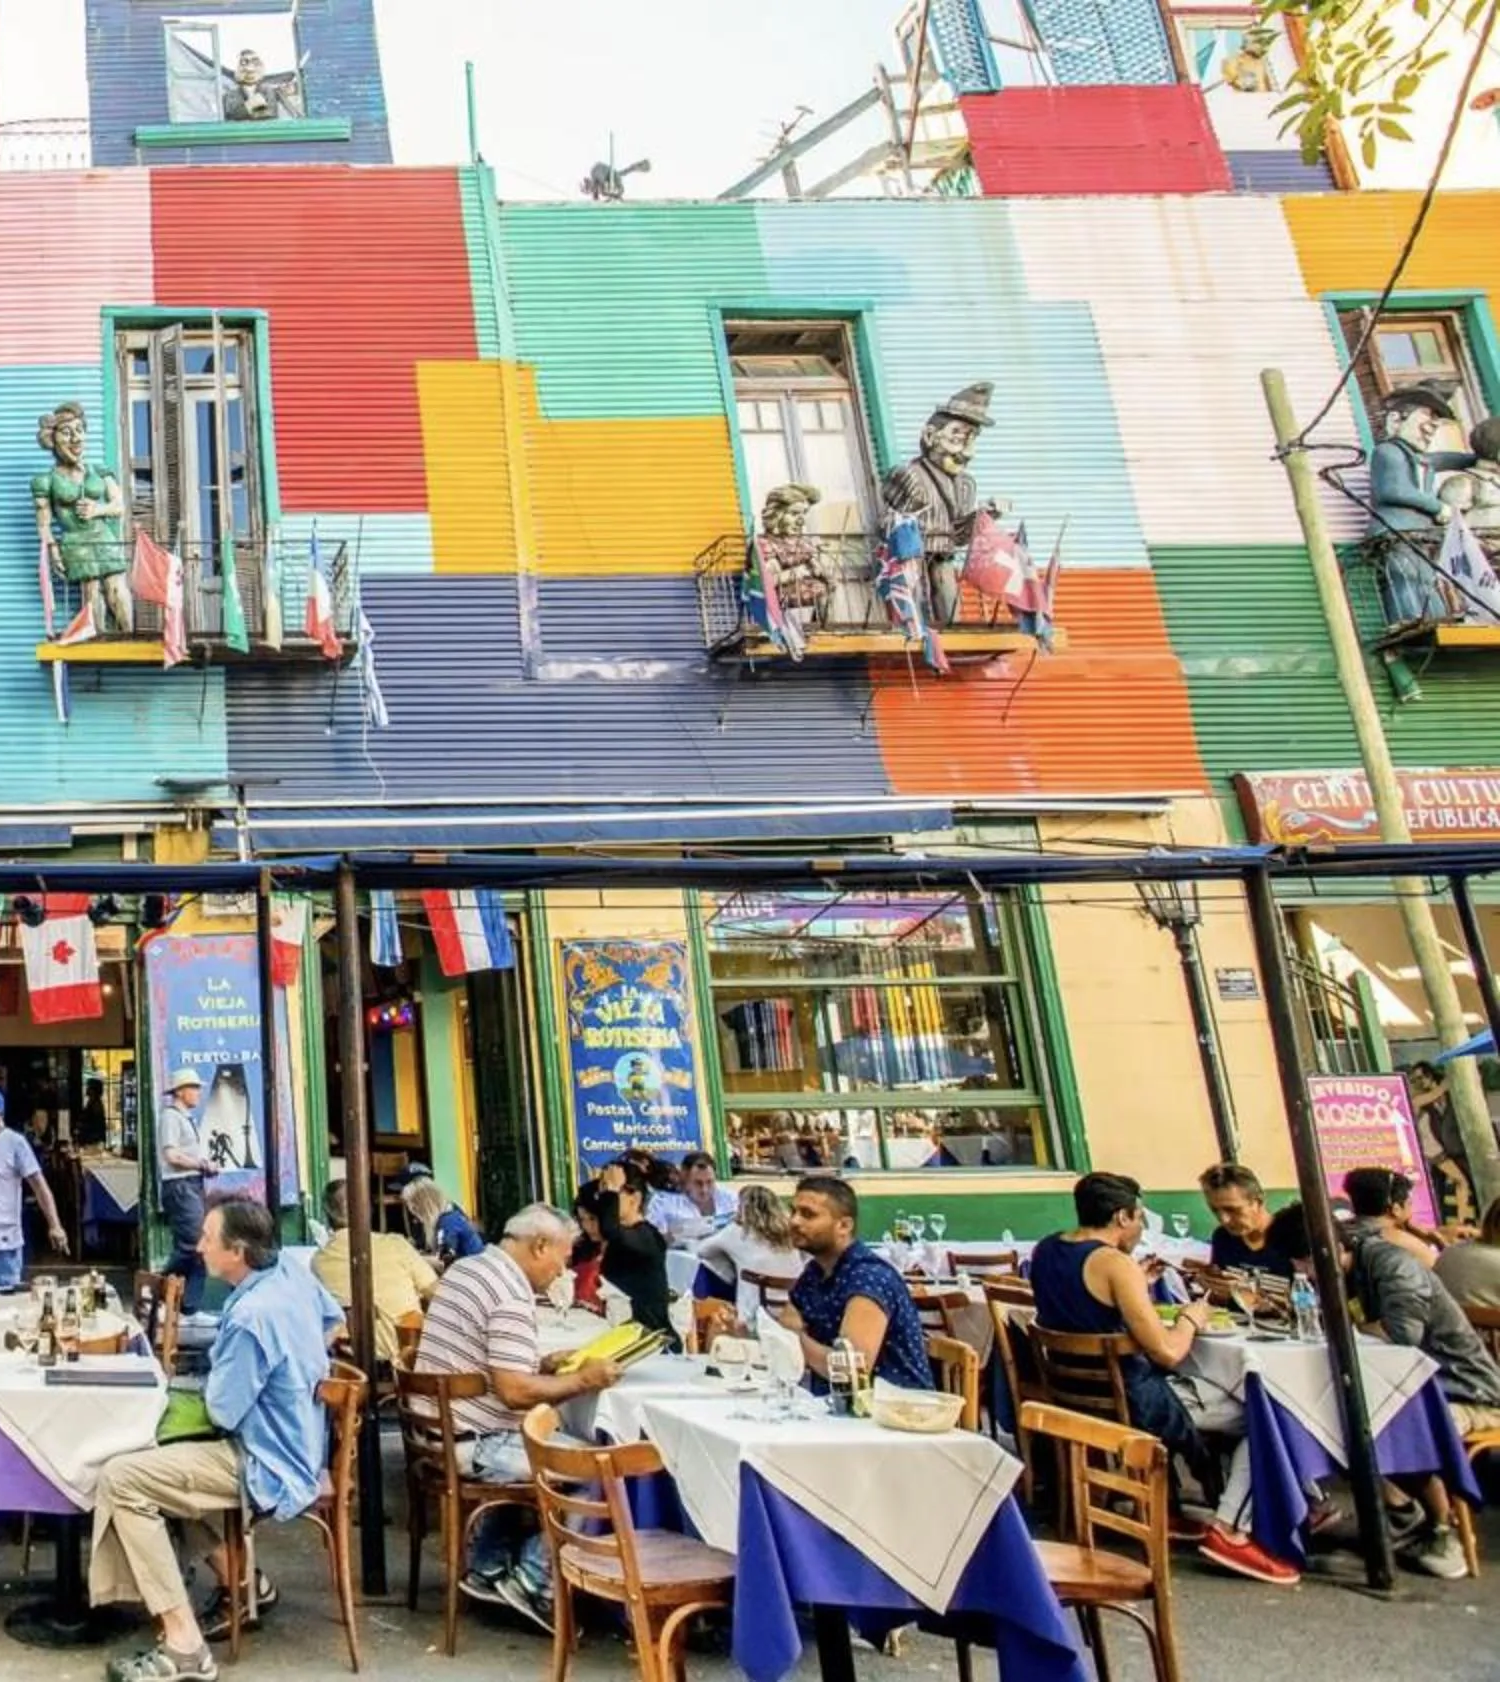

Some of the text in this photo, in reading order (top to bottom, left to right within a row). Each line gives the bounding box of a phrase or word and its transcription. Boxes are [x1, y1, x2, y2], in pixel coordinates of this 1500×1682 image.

[1293, 778, 1404, 808] CENT
[1405, 807, 1500, 829] EPUBLICA
[207, 977, 231, 991] LA
[198, 997, 247, 1010] VIEJA
[613, 1121, 672, 1135] Mariscos
